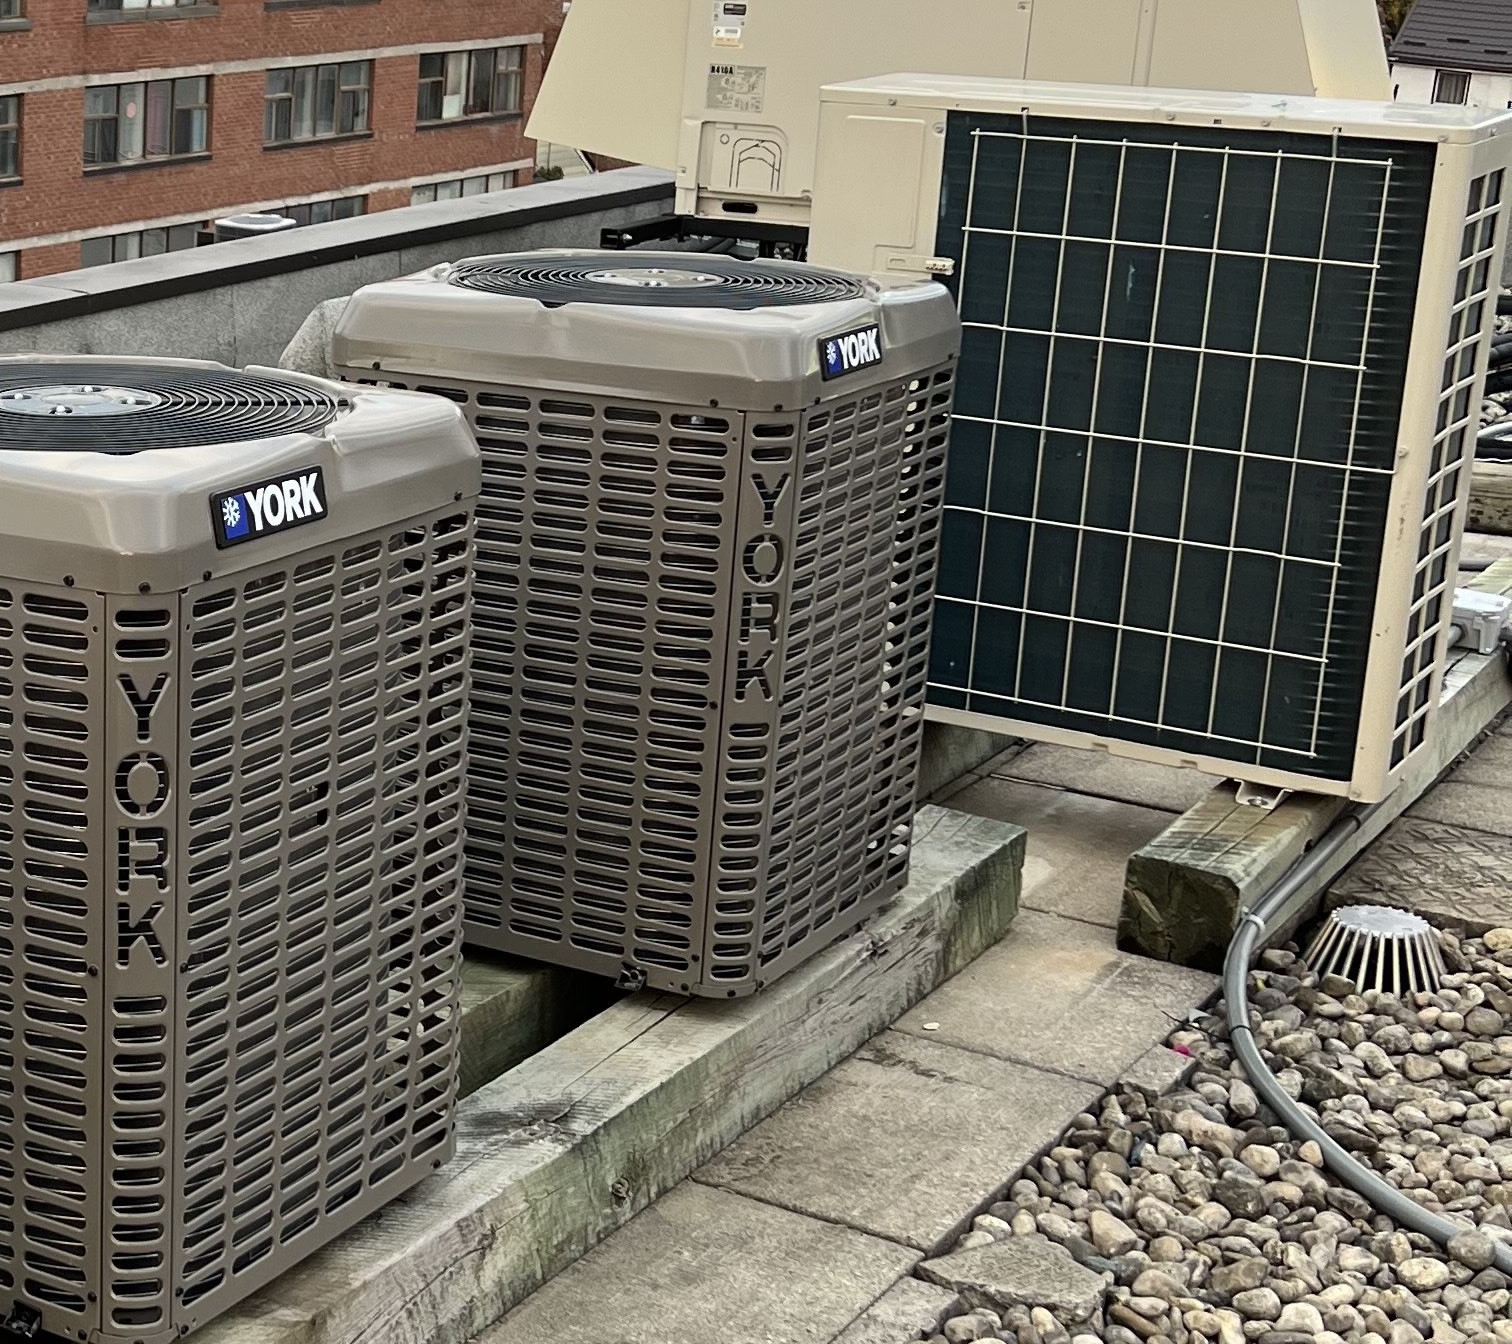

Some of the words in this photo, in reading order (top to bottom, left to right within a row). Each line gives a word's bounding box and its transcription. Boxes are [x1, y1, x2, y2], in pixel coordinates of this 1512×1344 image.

[837, 328, 880, 369] YORK
[244, 473, 323, 531] YORK
[734, 472, 791, 703] YORK
[113, 672, 172, 970] YORK
